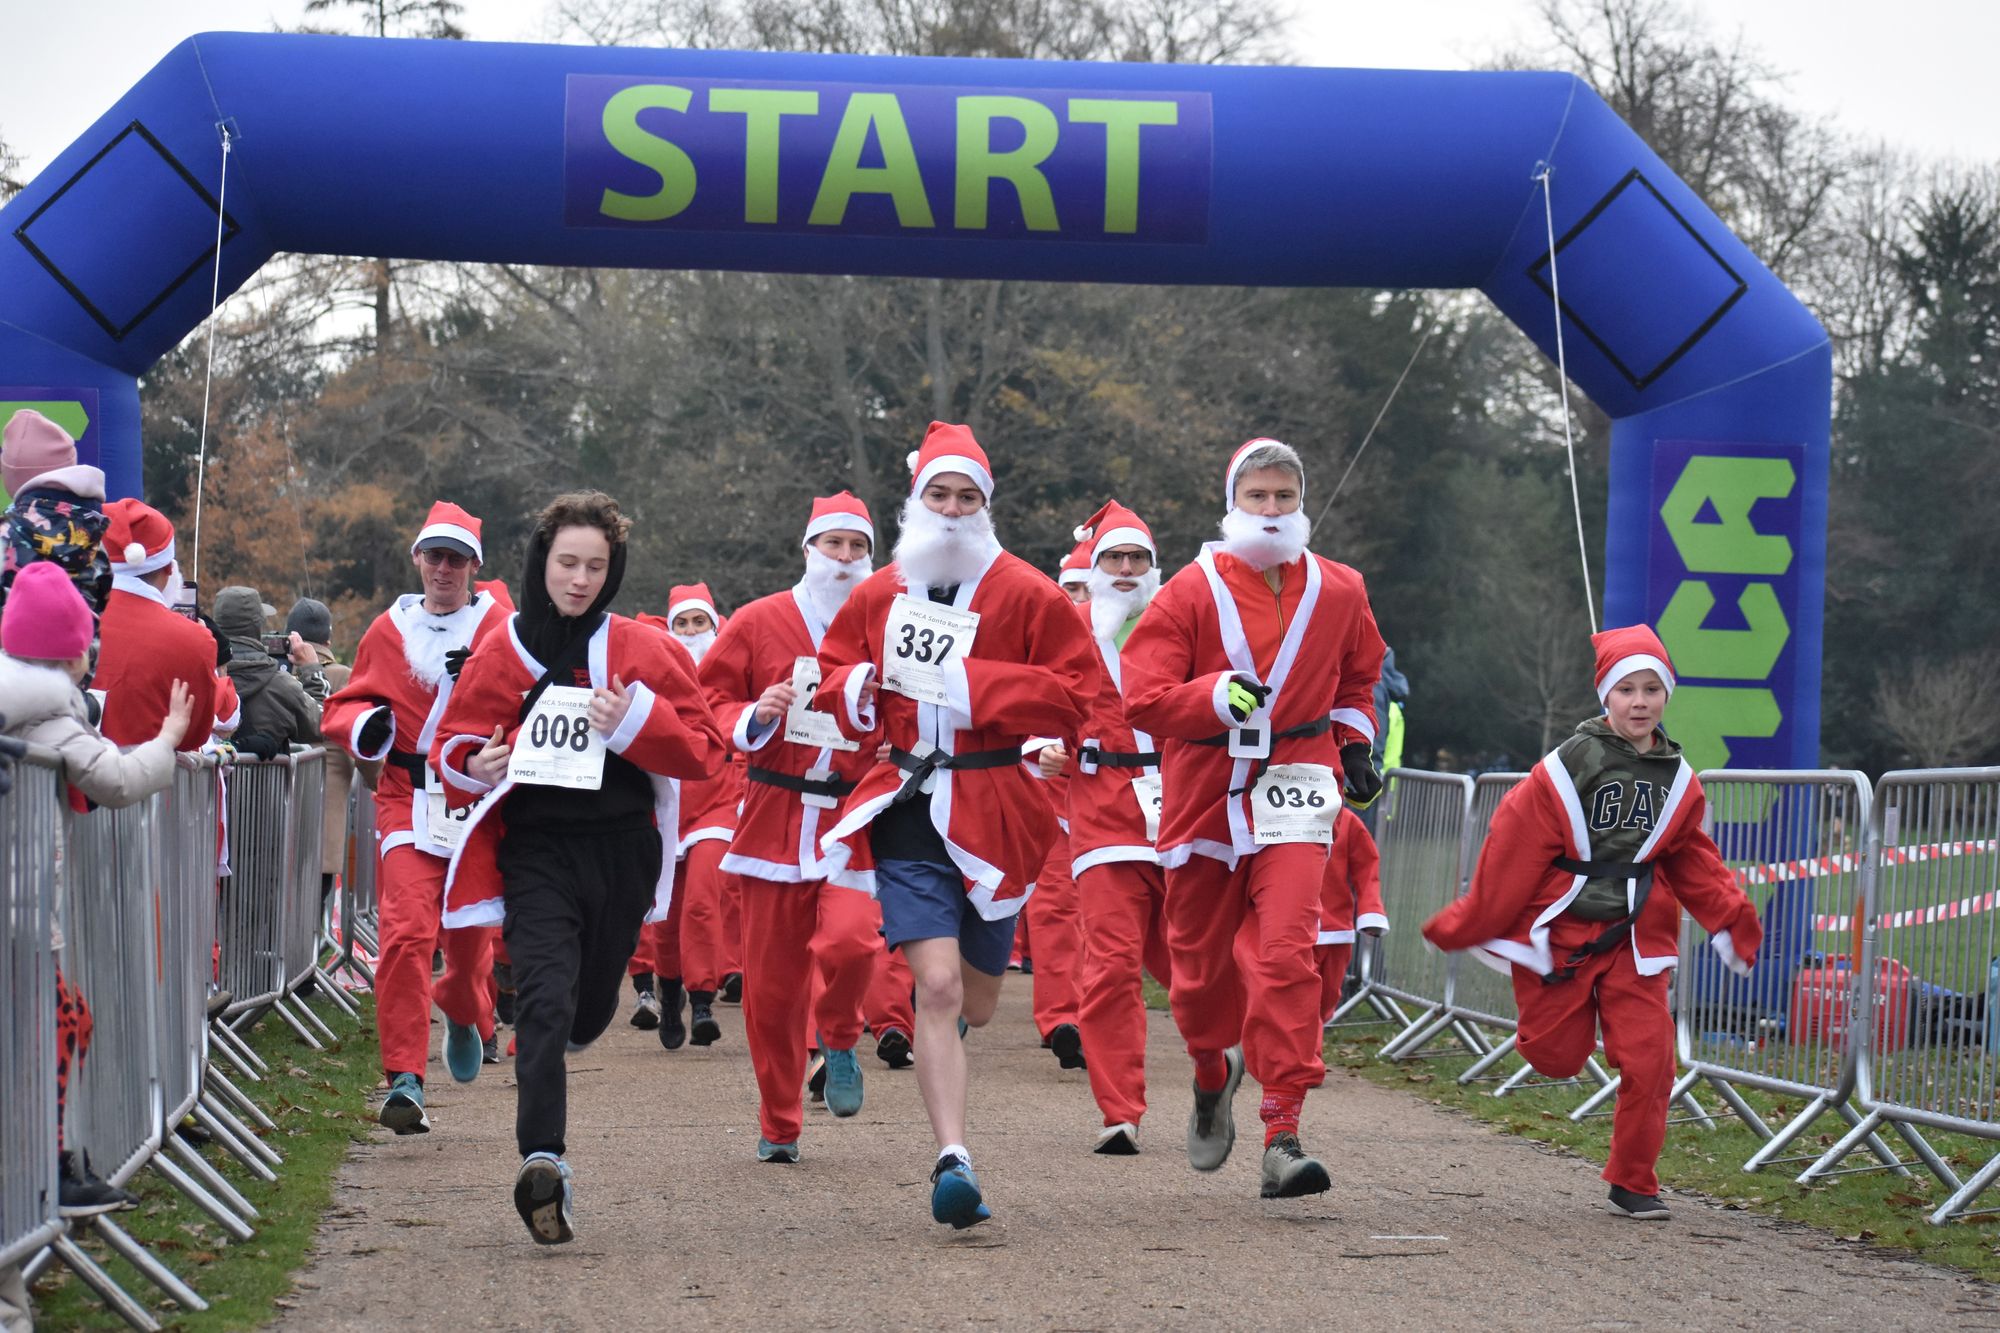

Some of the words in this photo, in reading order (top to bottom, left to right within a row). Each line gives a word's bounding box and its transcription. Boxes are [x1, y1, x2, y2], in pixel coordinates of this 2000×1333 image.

[599, 84, 1178, 233] START
[908, 610, 927, 620] YMCA
[928, 615, 946, 626] Santa
[947, 621, 959, 629] Run
[896, 623, 955, 666] 332
[557, 700, 577, 708] Santa
[531, 713, 590, 752] 008
[790, 729, 810, 739] YMCA
[513, 769, 537, 778] YMCA
[1266, 785, 1325, 808] 036
[1590, 780, 1670, 832] GA
[1260, 830, 1282, 838] YMCA
